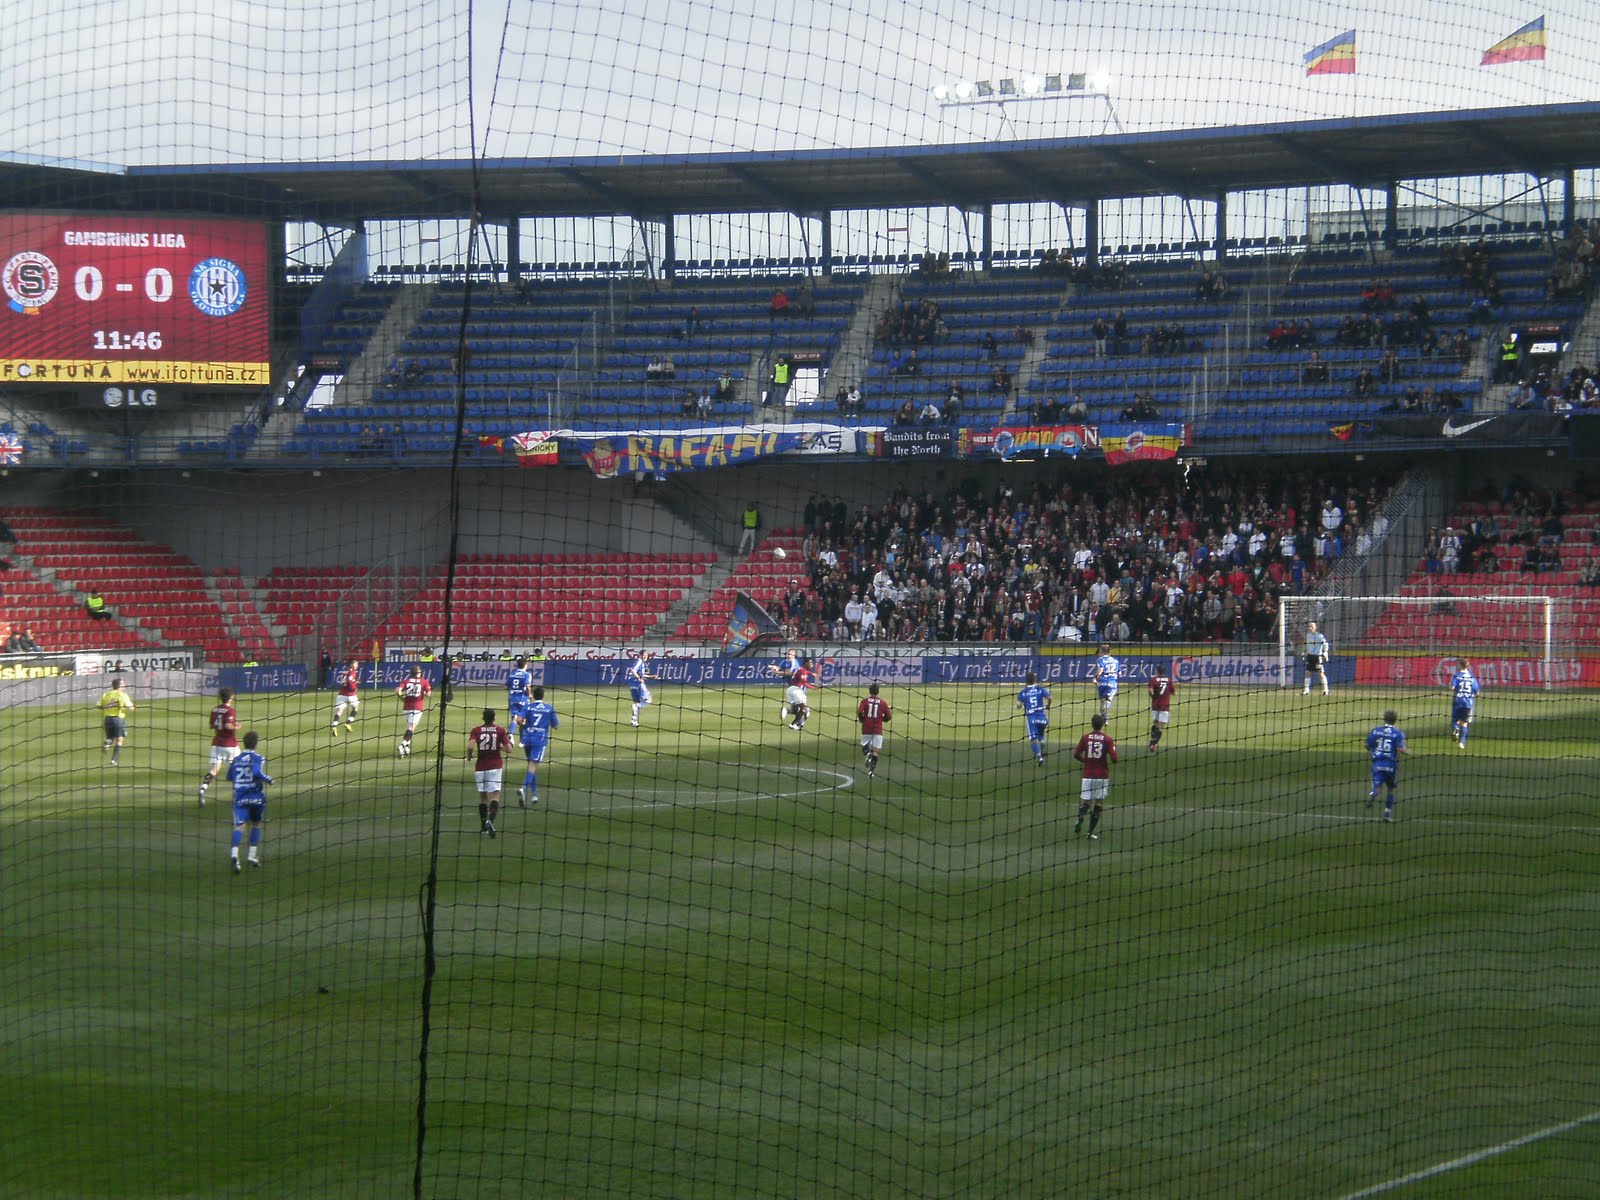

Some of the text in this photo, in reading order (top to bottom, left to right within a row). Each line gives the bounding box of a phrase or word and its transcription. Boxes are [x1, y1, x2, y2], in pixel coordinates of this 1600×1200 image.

[64, 231, 186, 248] GAMBRINUS LIGA
[208, 258, 240, 277] SIGMA
[74, 266, 103, 301] 0
[145, 267, 173, 302] 0
[93, 330, 162, 350] 11:46
[3, 364, 257, 382] FORTUNA www.ifortuna.cz
[128, 389, 157, 406] LG
[883, 432, 923, 442] Bandits
[893, 445, 941, 456] the North
[600, 664, 620, 684] Ty
[656, 662, 692, 682] titul,
[697, 660, 715, 684] já
[721, 663, 732, 679] ti
[820, 660, 922, 678] aktuálně.cz
[939, 661, 959, 681] Ty
[964, 659, 992, 678] mě
[1042, 658, 1062, 681] já
[1069, 660, 1081, 678] ti
[1179, 659, 1293, 678] aktuálně.cz
[244, 671, 259, 691] Ty
[1159, 682, 1167, 695] 7
[1458, 681, 1473, 693] 15
[867, 703, 879, 718] 11
[533, 714, 543, 726] 7
[479, 734, 498, 751] 21
[1087, 741, 1103, 759] 13
